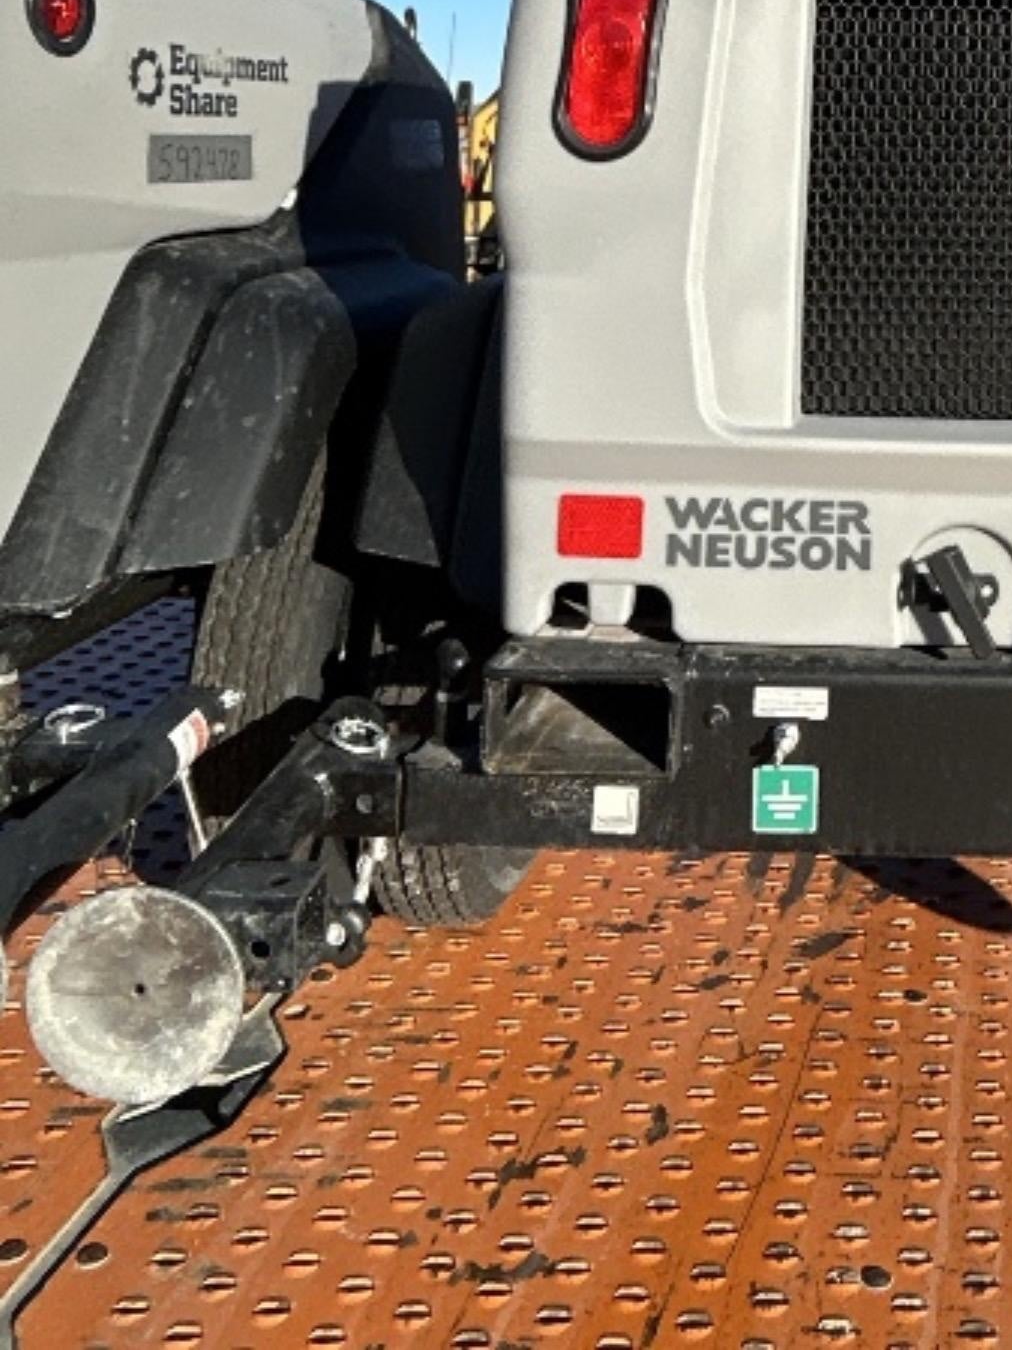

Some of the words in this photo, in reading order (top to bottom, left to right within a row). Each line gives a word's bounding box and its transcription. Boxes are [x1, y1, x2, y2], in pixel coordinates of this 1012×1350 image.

[169, 83, 238, 117] Share
[664, 497, 872, 535] WACKER
[664, 533, 872, 571] NEUSON
